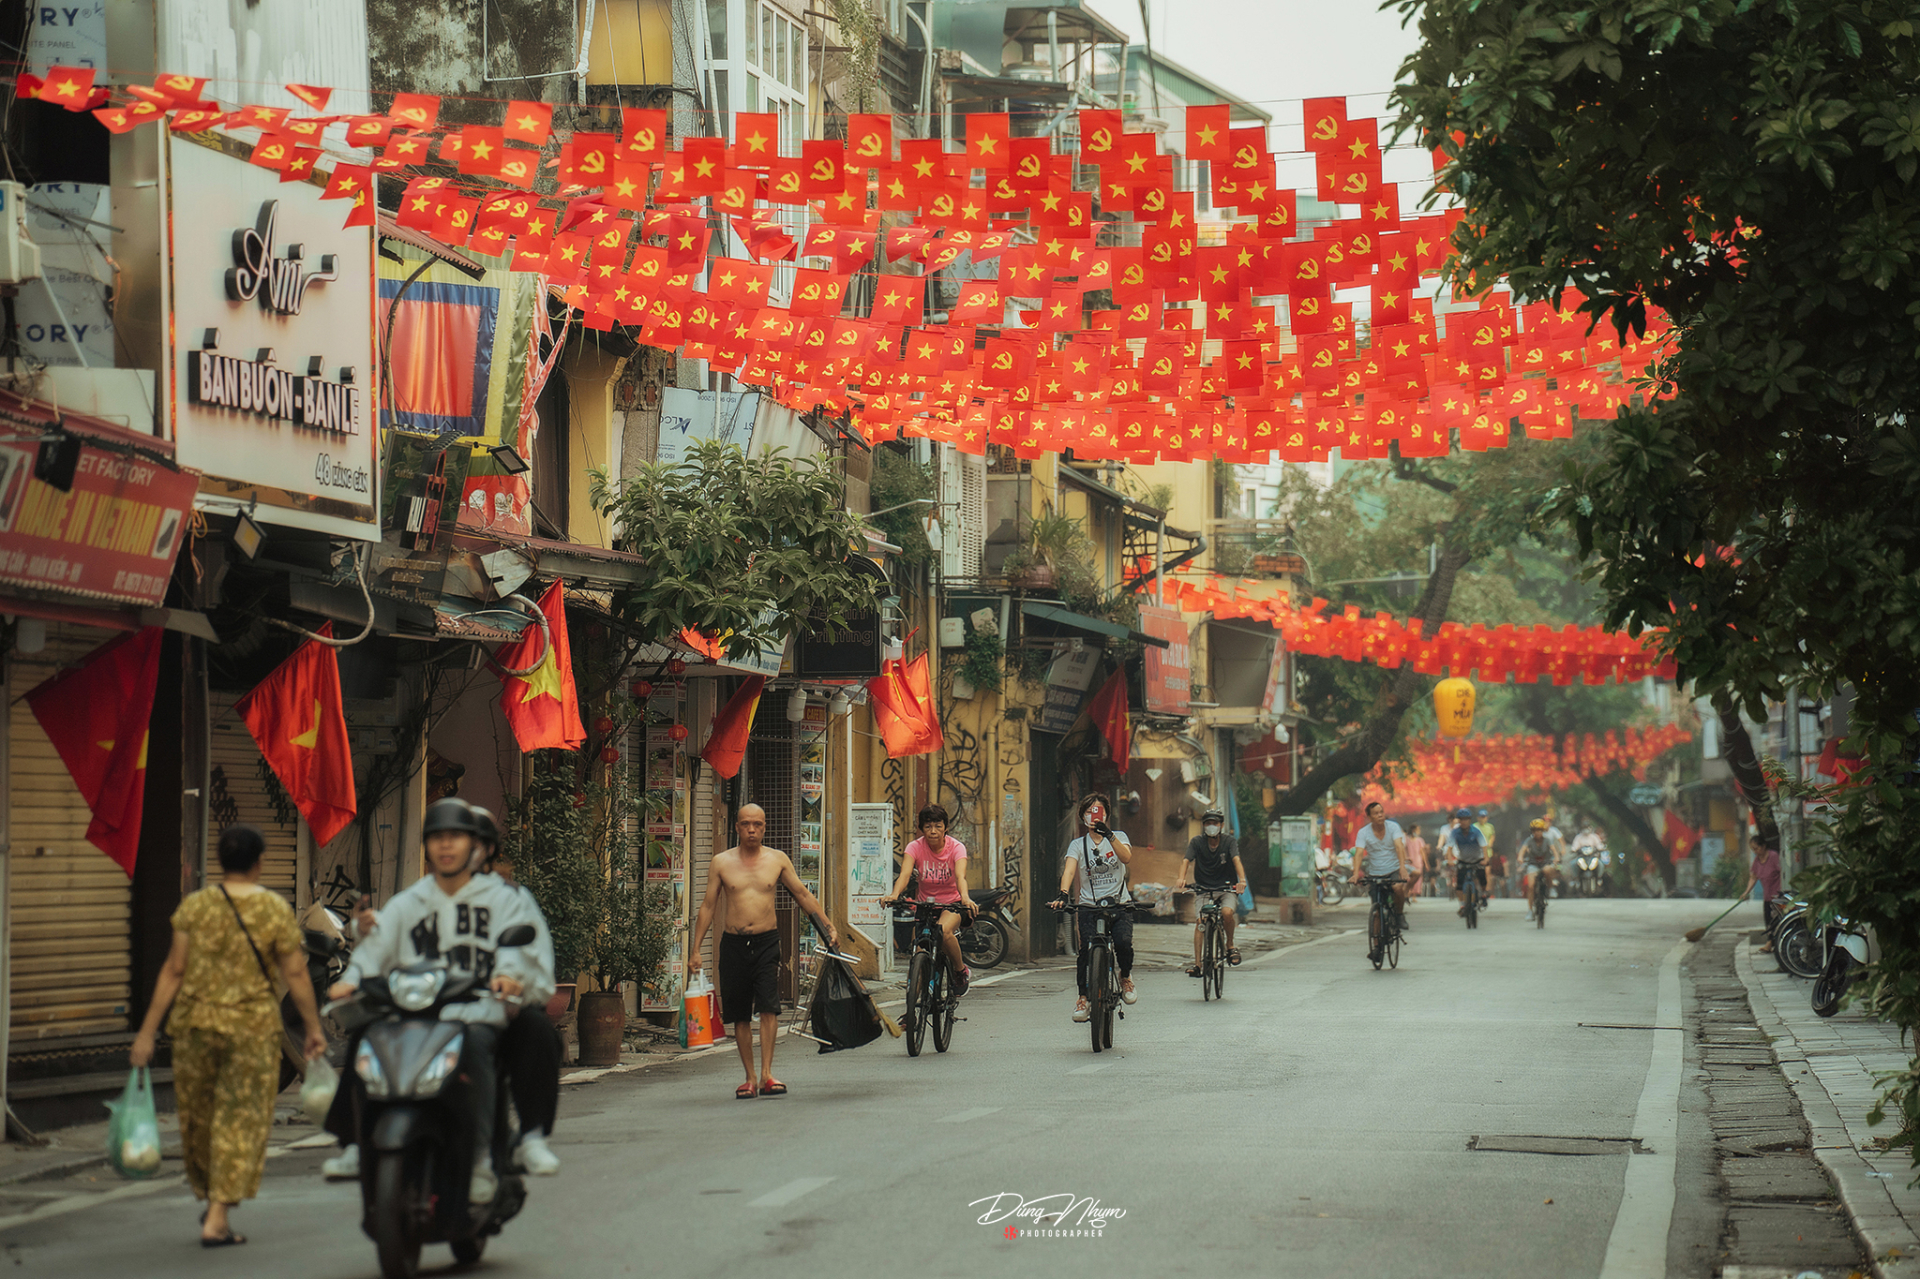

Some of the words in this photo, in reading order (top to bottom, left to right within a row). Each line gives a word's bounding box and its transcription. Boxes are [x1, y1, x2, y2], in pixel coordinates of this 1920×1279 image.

[96, 456, 156, 488] FACTORY
[315, 452, 331, 486] 48
[15, 479, 75, 541] MADE
[64, 490, 96, 545] IN
[86, 494, 162, 556] VIETNAM
[804, 627, 874, 647] Printing
